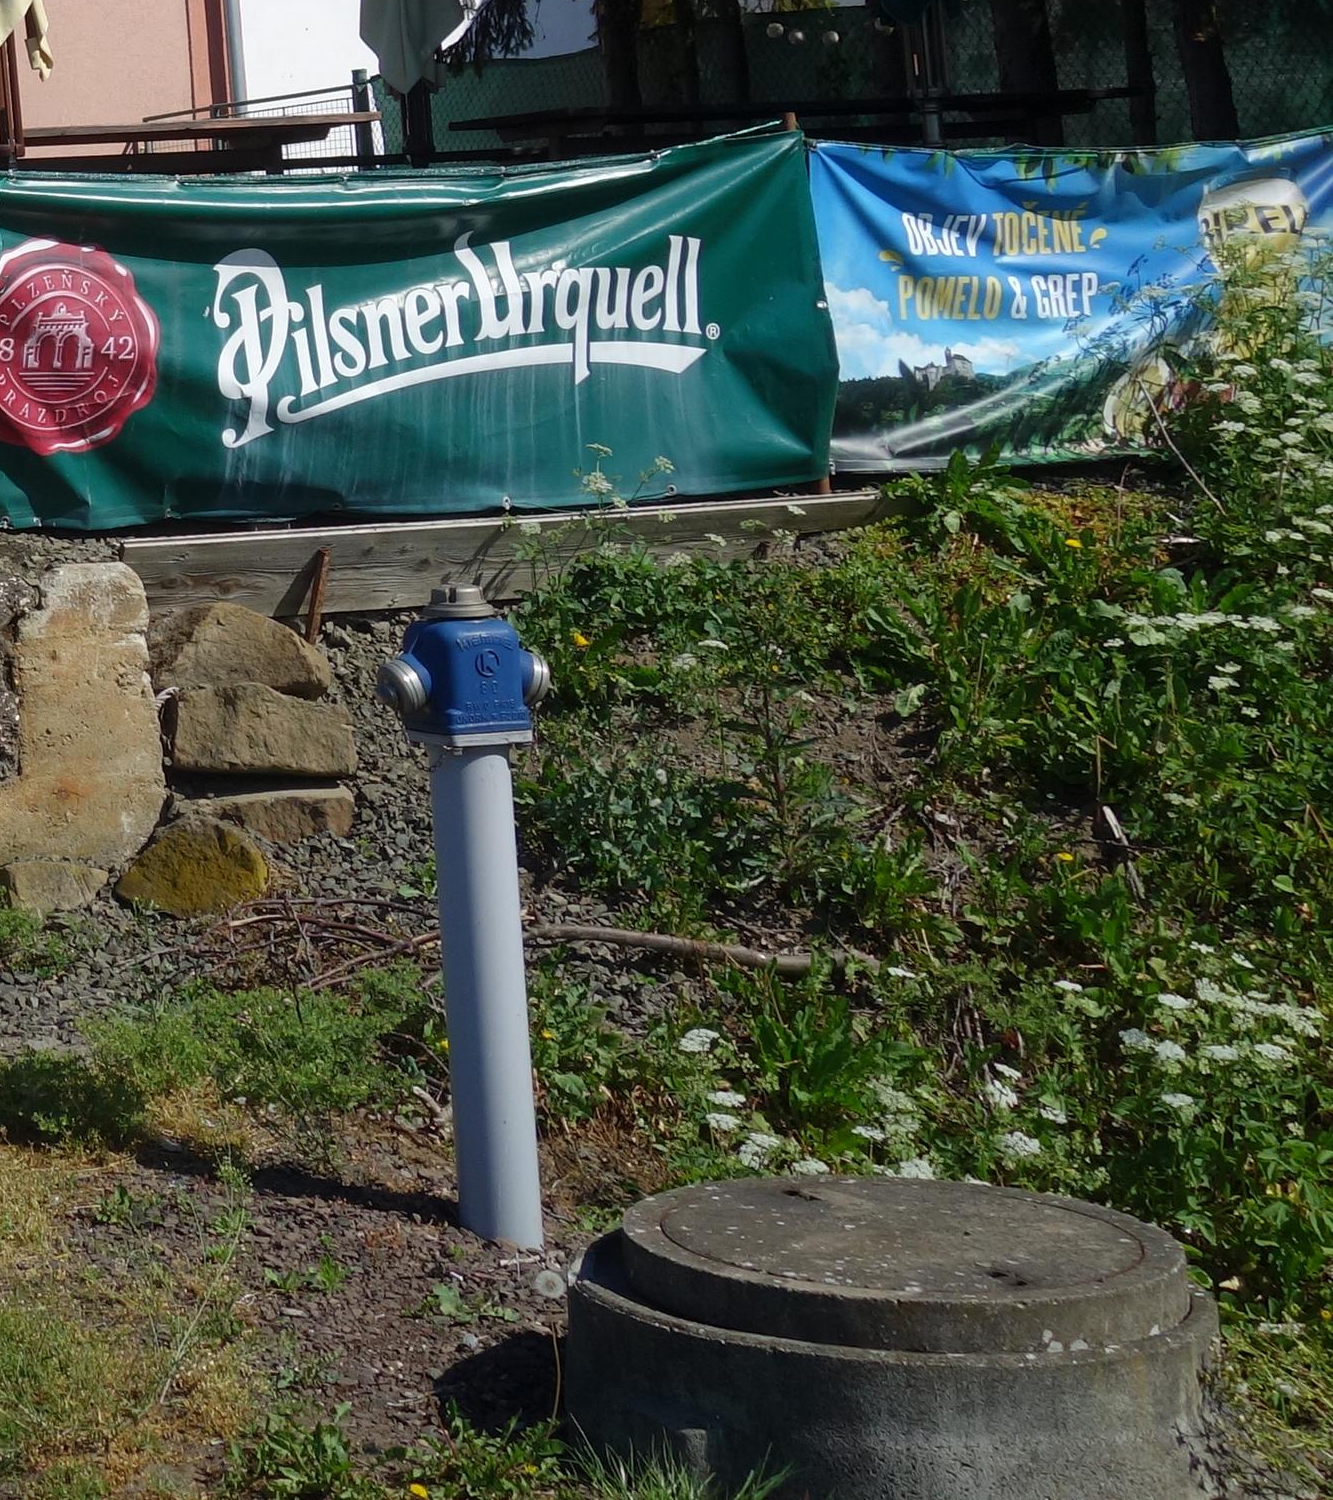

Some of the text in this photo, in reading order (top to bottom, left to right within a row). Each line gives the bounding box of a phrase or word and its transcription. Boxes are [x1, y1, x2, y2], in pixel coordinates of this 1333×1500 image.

[901, 201, 1087, 257] OBJEV TOČENÉ
[898, 272, 1099, 321] POMELO & GREP
[100, 336, 135, 361] 42
[212, 230, 702, 449] Pilsner Urquell
